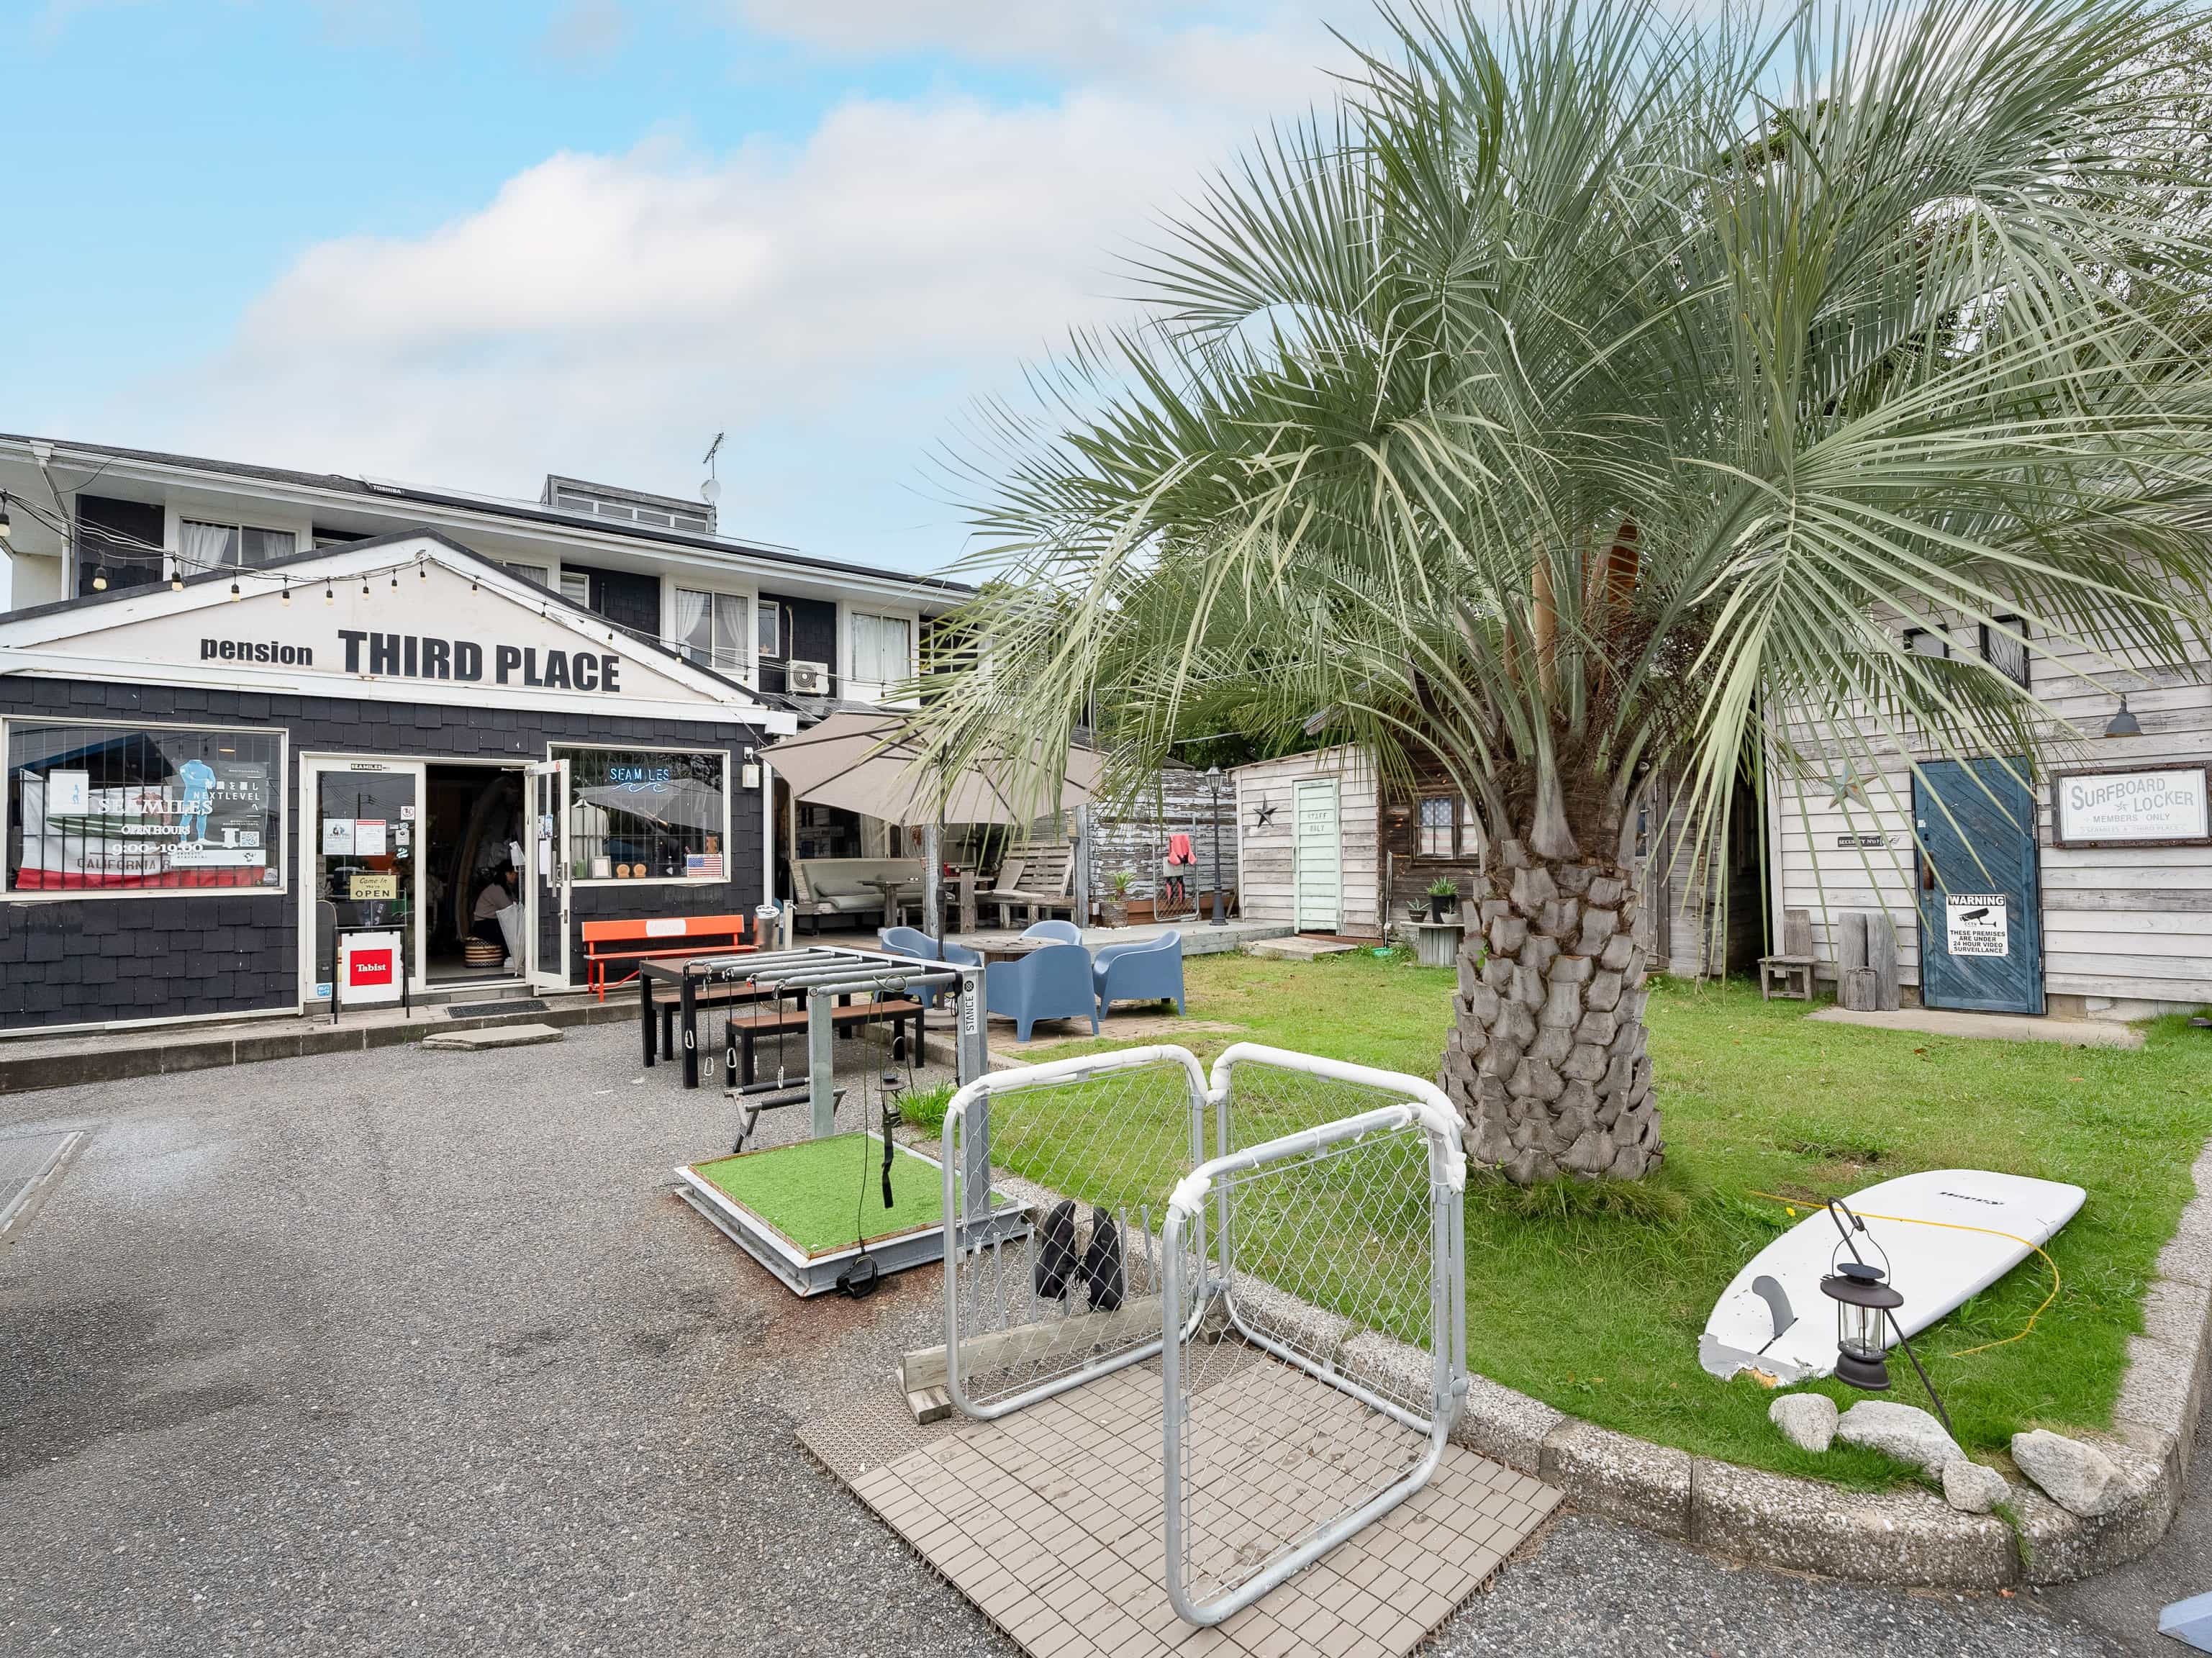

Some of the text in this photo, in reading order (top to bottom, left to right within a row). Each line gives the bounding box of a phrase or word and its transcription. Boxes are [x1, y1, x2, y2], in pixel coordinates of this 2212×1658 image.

[373, 485, 401, 494] TOSHIBA
[201, 629, 620, 692] pension THIRD PLACE
[2071, 778, 2165, 810] SURFBOARD
[98, 798, 213, 815] SEAMILES
[2134, 790, 2193, 812] LOCKER
[2093, 814, 2138, 823] MEMBERS
[153, 825, 191, 835] HOURS
[77, 858, 156, 870] CALIFORNIA
[1949, 896, 2004, 905] WARNING
[355, 963, 386, 972] Tabist
[966, 996, 974, 1031] STANCE
